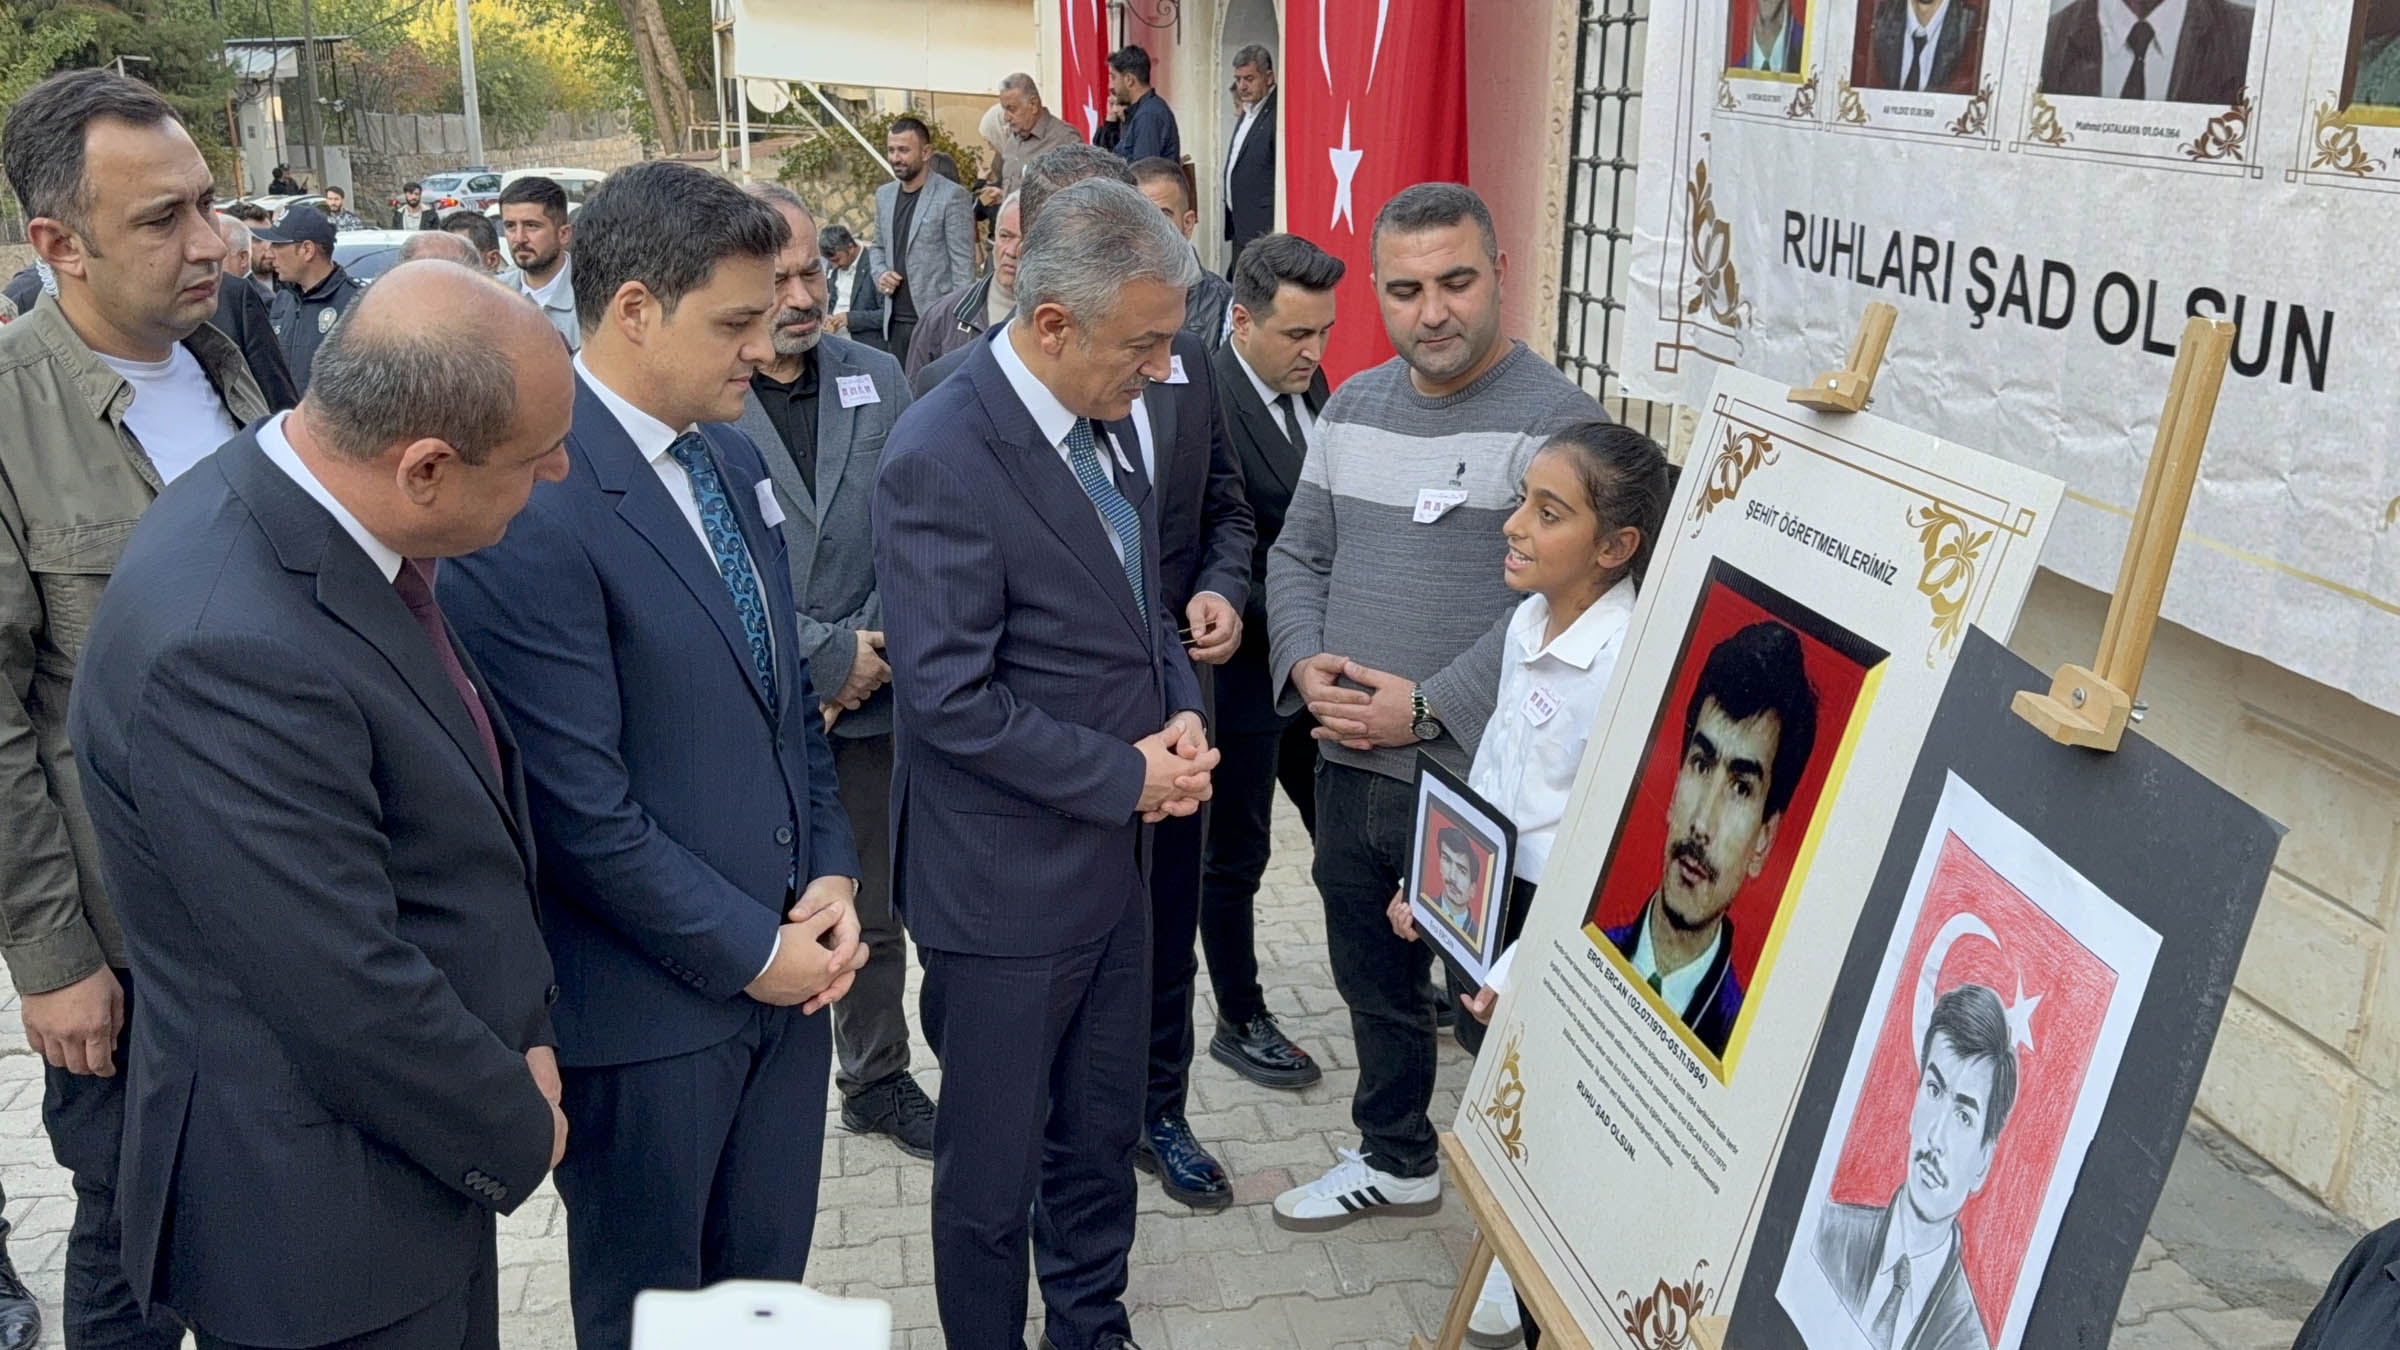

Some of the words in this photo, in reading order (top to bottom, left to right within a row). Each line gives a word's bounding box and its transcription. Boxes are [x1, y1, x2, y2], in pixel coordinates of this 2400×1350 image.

[1783, 209, 1955, 304] RUHLARI
[1965, 246, 2076, 330] ŞAD
[1745, 499, 1780, 528] ŞEHİT
[1778, 511, 1898, 586] ÖĞRETMENLERİMİZ
[1587, 948, 1604, 972] EROL
[1604, 967, 1628, 998] ERCAN
[1576, 1080, 1596, 1107] RUHU
[1595, 1104, 1611, 1126] ŞAD
[1610, 1123, 1636, 1161] OLSUN.
